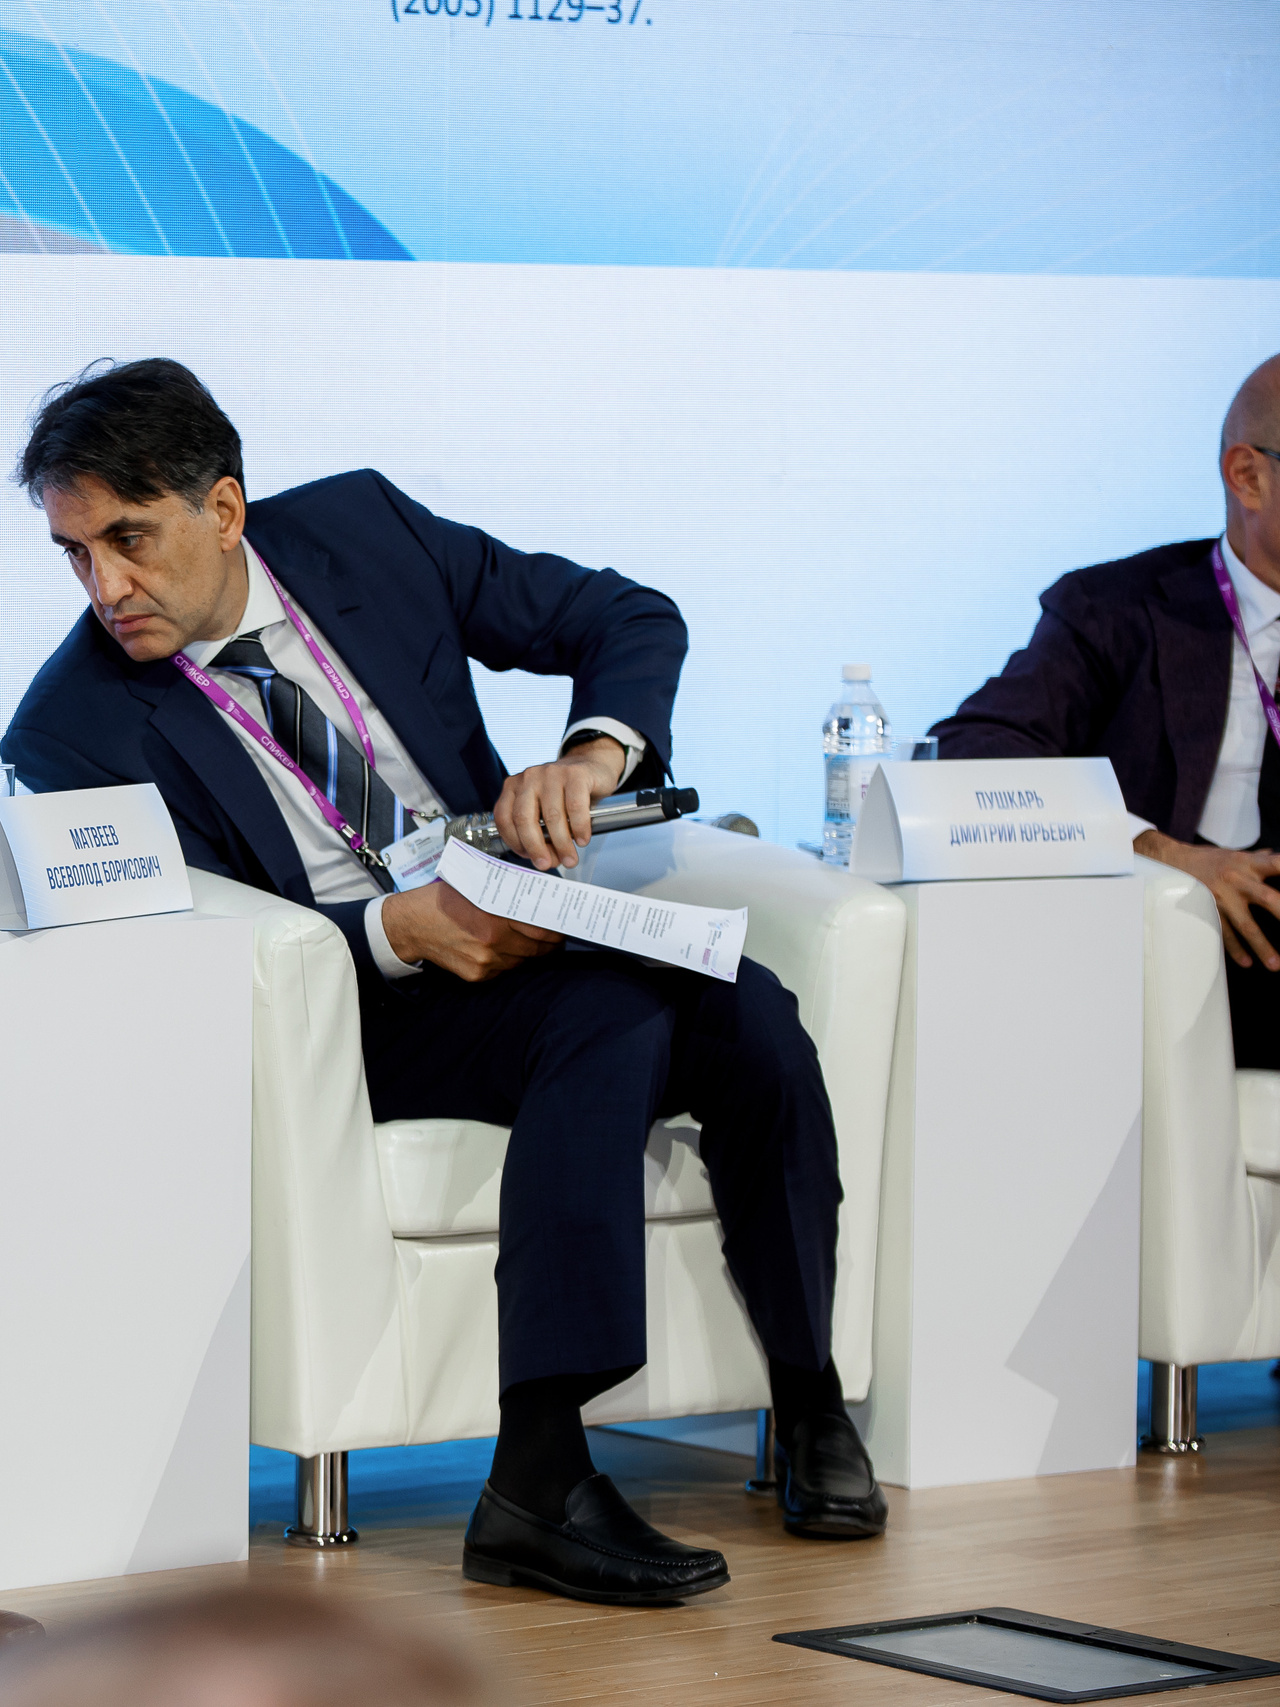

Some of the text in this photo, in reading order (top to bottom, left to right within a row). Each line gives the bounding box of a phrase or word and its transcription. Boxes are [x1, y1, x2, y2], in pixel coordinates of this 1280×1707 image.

[174, 655, 211, 687] СПИКЕР
[322, 662, 350, 700] СПИКЕР
[260, 735, 295, 769] СПИКЕР
[975, 790, 1045, 810] ПУШКАРЬ
[69, 824, 120, 850] МАТВЕЕВ
[1020, 821, 1086, 843] ЮРЬЕВИЧ
[46, 855, 162, 889] ВСЕВОЛОД БОРИСОВИЧ
